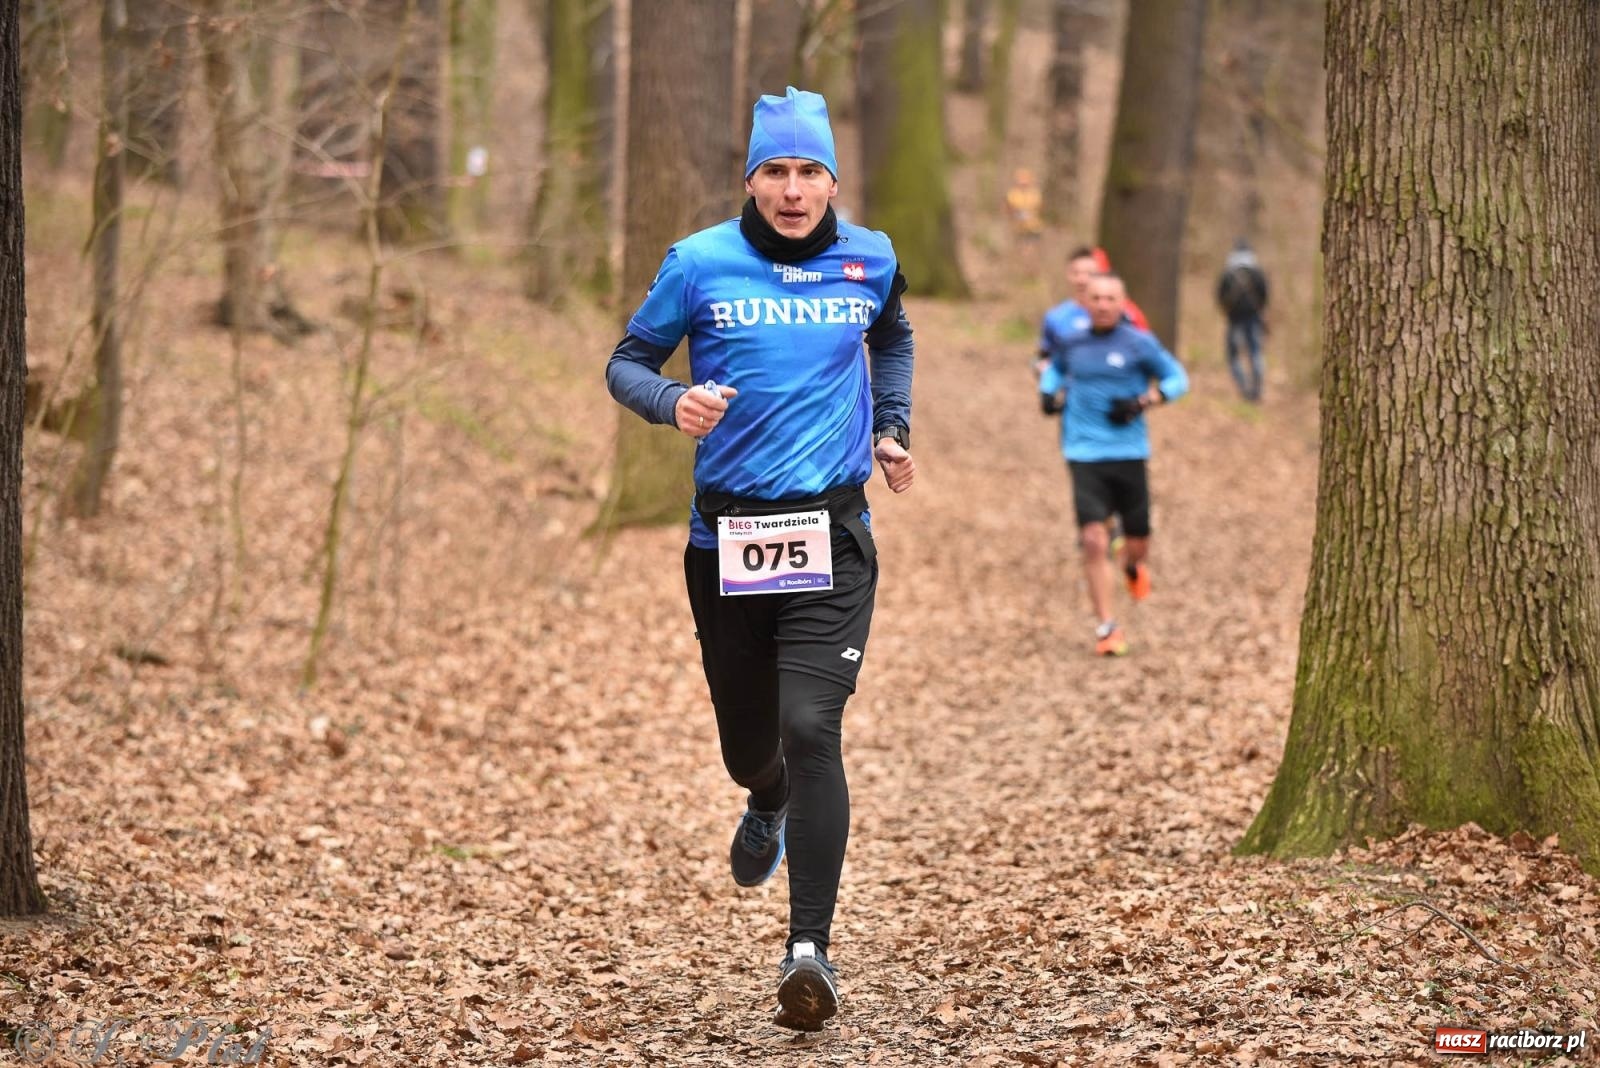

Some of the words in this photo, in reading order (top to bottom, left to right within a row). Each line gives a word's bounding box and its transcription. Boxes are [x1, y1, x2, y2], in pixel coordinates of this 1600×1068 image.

[728, 520, 752, 530] BIEG
[754, 516, 819, 529] Twardziela
[742, 540, 809, 572] 075
